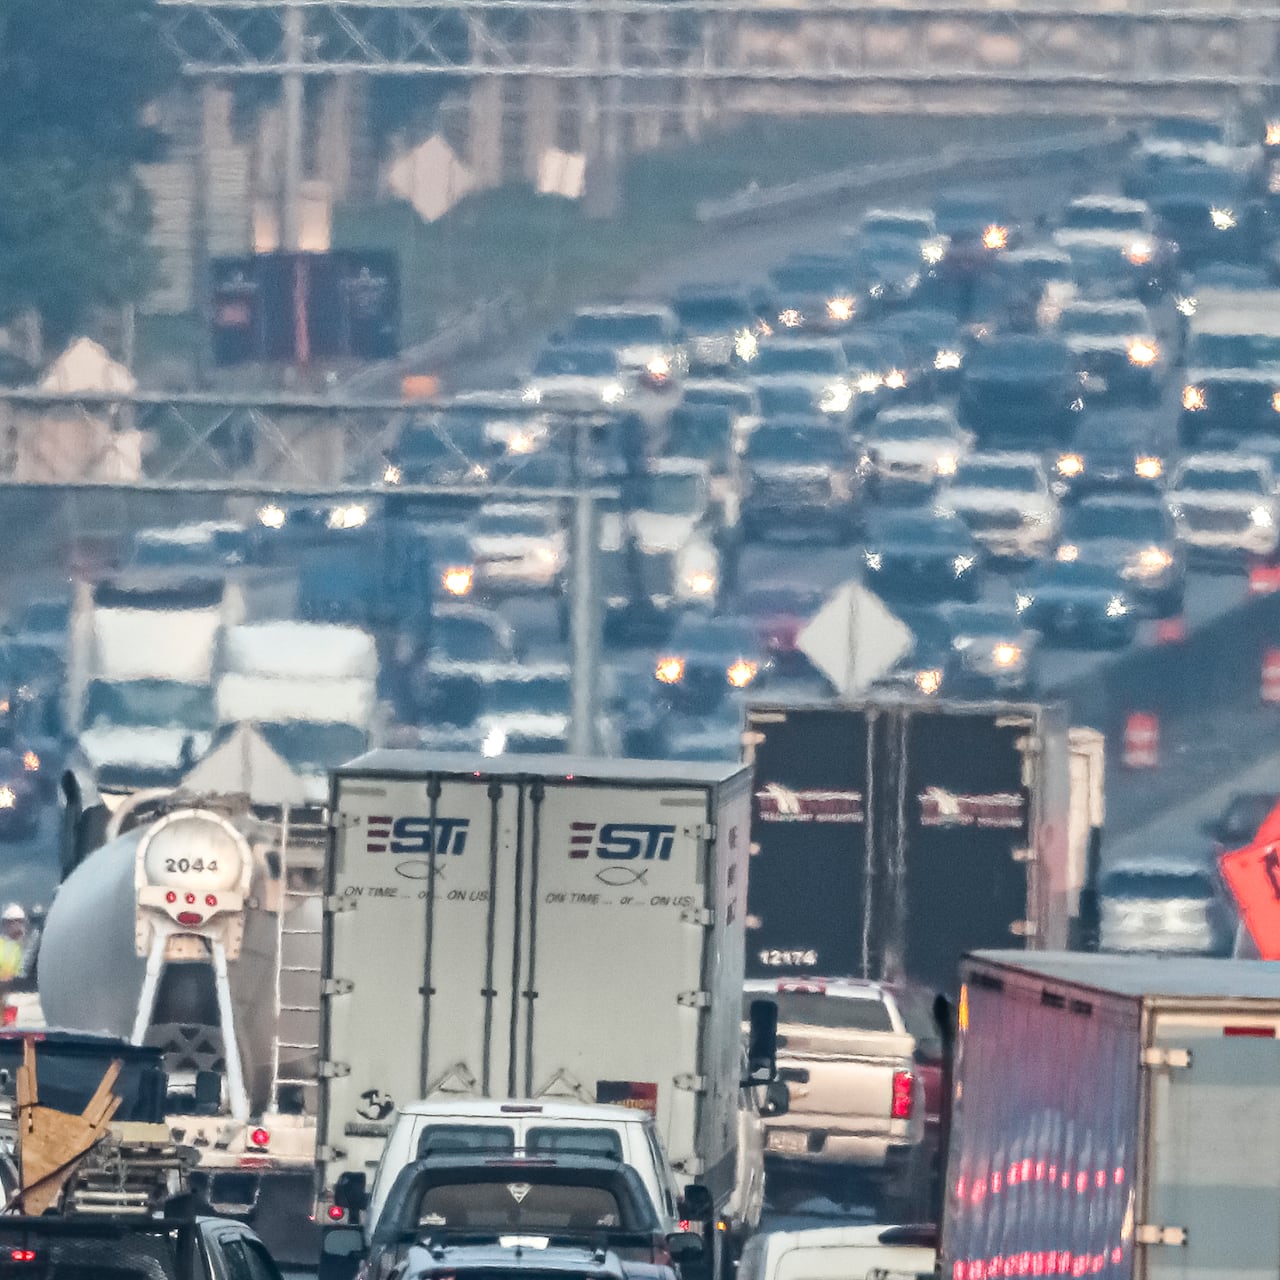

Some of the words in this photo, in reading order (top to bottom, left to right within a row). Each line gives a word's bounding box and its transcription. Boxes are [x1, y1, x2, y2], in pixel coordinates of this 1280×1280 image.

[165, 857, 219, 874] 2044
[344, 886, 364, 897] ON
[446, 889, 467, 901] ON
